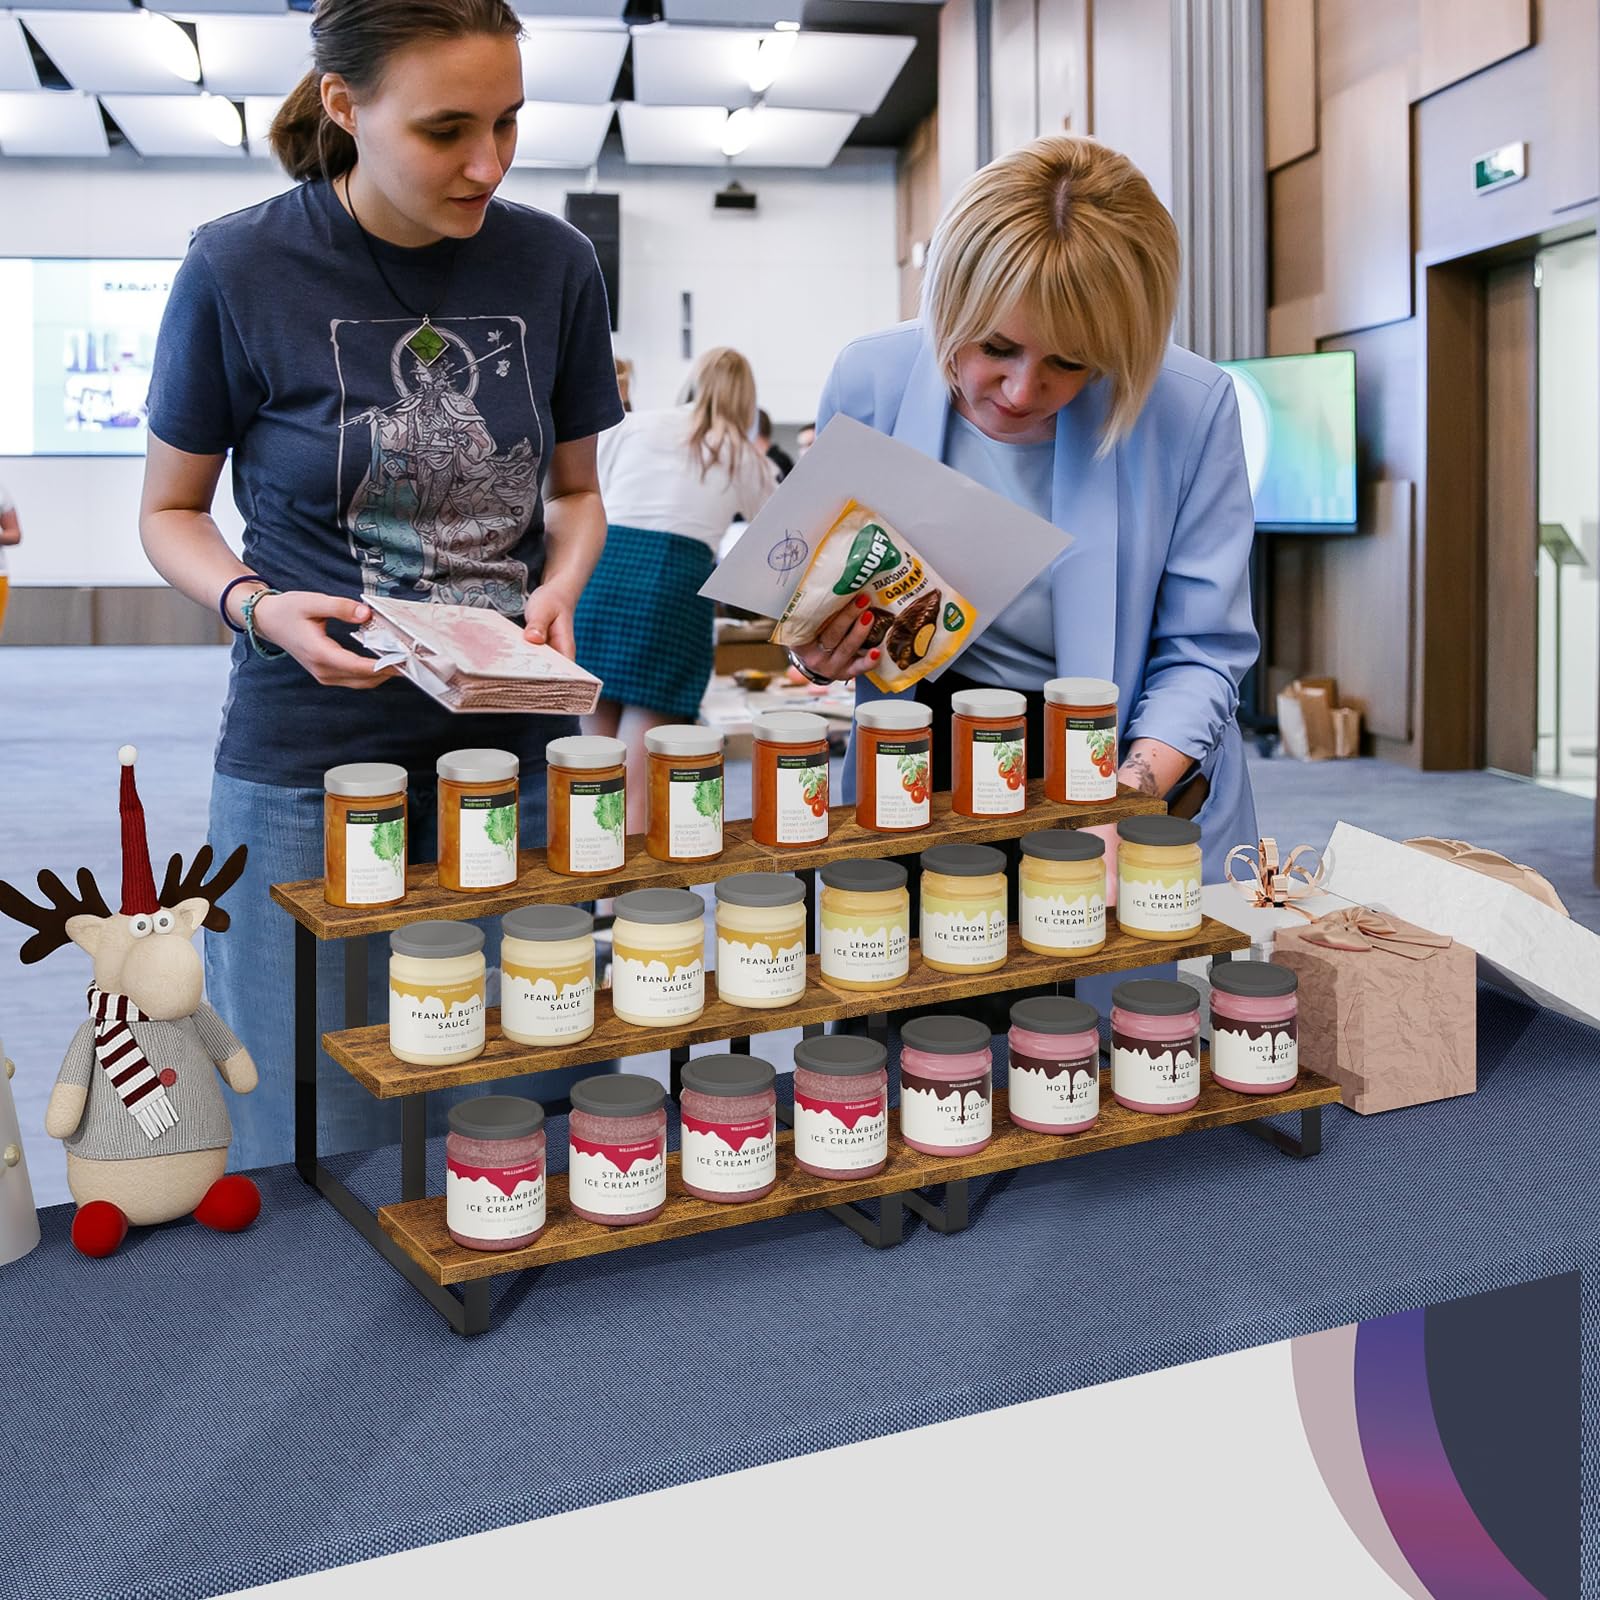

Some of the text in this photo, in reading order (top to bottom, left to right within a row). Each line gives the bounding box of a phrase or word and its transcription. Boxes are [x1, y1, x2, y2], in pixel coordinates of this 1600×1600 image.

[1133, 899, 1146, 908] ICE
[1151, 901, 1183, 909] CREAM
[1051, 908, 1084, 916] LEMON
[1035, 915, 1049, 924] ICE
[1053, 917, 1085, 925] CREAM
[951, 925, 984, 933] LEMON
[934, 932, 947, 940] ICE
[952, 934, 985, 942] CREAM
[849, 941, 884, 949] LEMON
[833, 948, 847, 957] ICE
[851, 950, 885, 959] CREAM
[740, 957, 780, 965] PEANUT
[765, 964, 795, 975] SAUCE
[636, 974, 676, 983] PEANUT
[662, 982, 693, 993] SAUCE
[524, 992, 565, 1001] PEANUT
[549, 1000, 581, 1012] SAUCE
[411, 1010, 453, 1020] PEANUT
[438, 1018, 471, 1030] SAUCE
[1249, 1045, 1269, 1053] HOT
[1262, 1052, 1289, 1062] SAUCE
[1149, 1064, 1169, 1072] HOT
[1162, 1071, 1190, 1081] SAUCE
[1046, 1084, 1067, 1092] HOT
[1059, 1091, 1088, 1101] SAUCE
[937, 1105, 957, 1113] HOT
[950, 1112, 980, 1122] SAUCE
[811, 1135, 825, 1143] ICE
[830, 1136, 864, 1145] CREAM
[696, 1156, 711, 1165] ICE
[716, 1159, 751, 1167] CREAM
[584, 1178, 599, 1187] ICE
[604, 1179, 639, 1189] CREAM
[466, 1203, 482, 1213] ICE
[487, 1204, 523, 1214] CREAM
